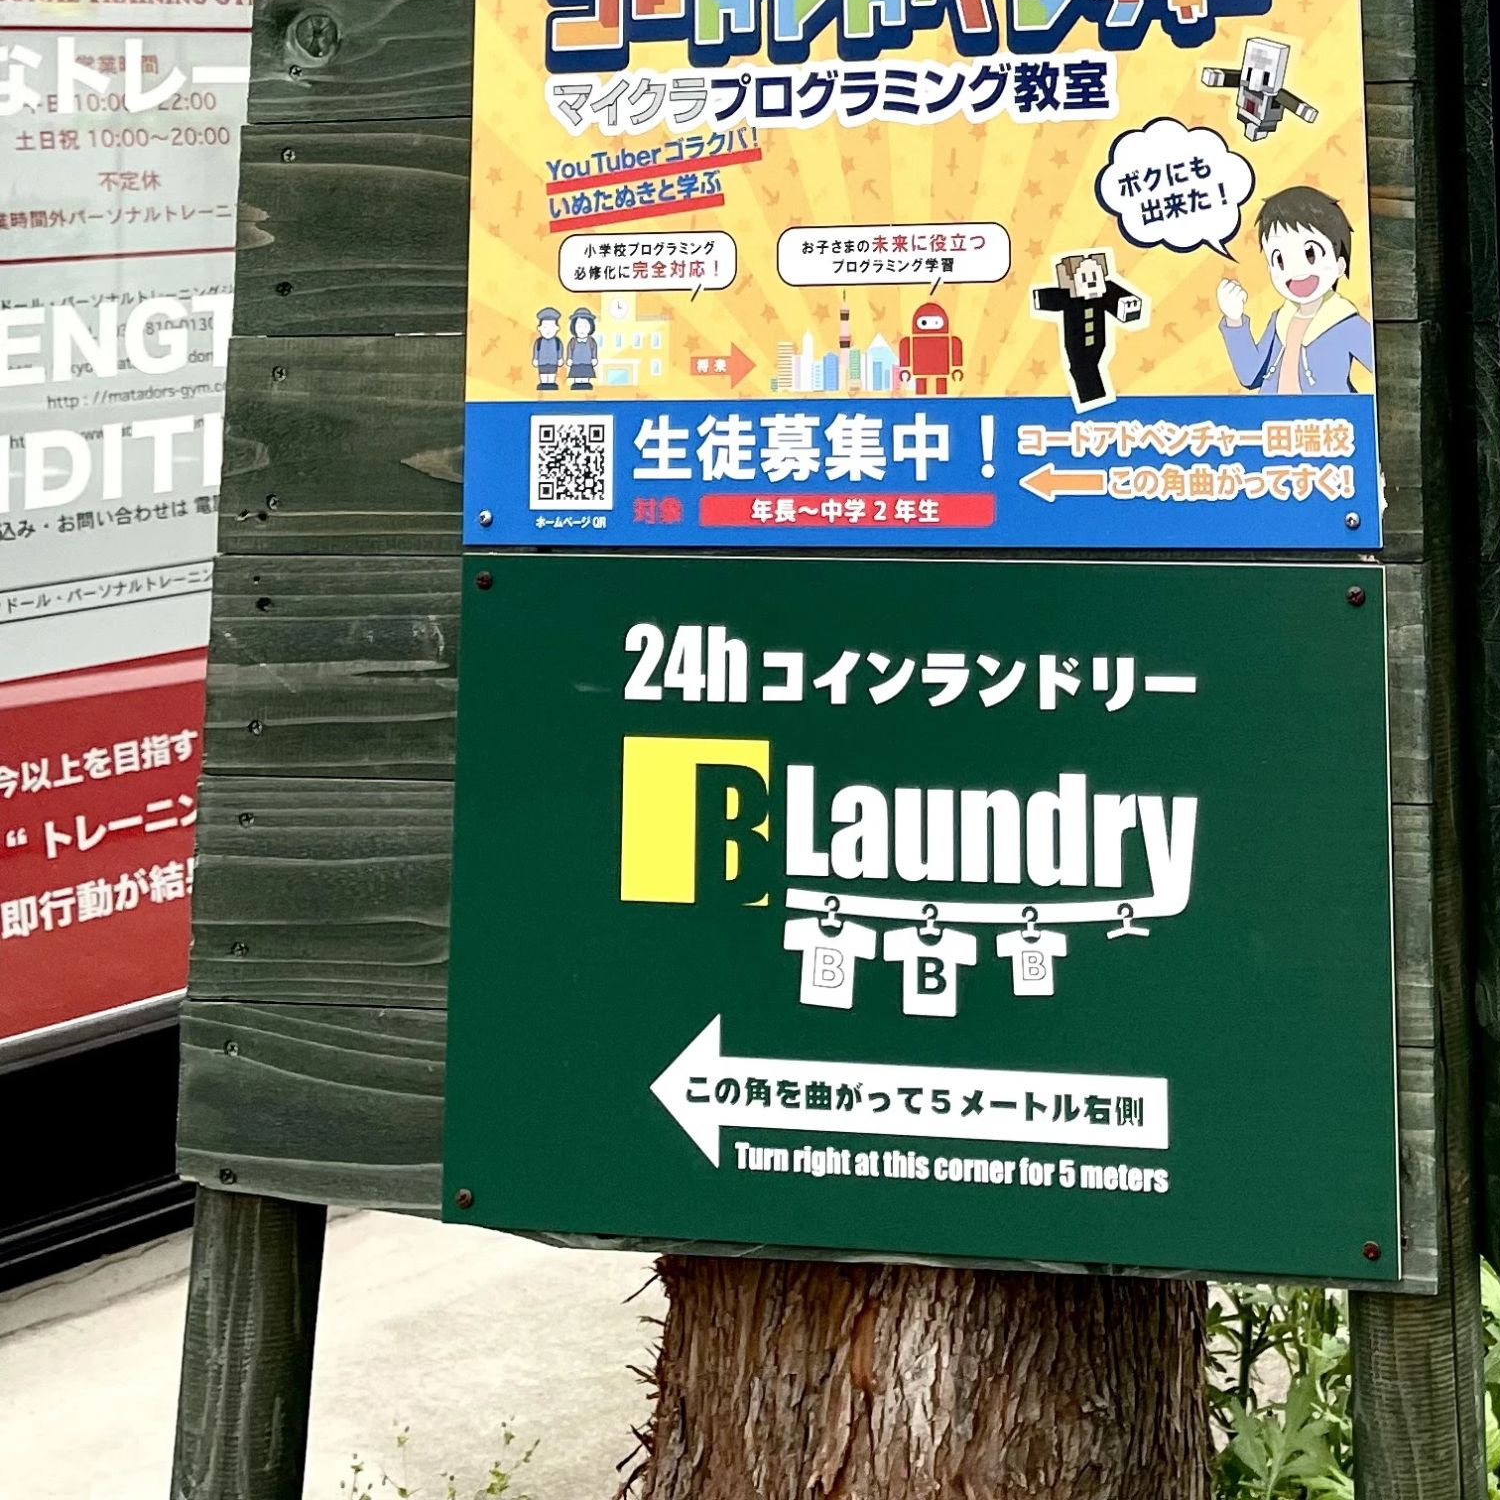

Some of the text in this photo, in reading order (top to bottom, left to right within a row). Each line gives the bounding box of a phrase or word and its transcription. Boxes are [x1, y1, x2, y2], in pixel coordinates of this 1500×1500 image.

[552, 59, 1111, 128] マイクラプログラミング教室
[16, 129, 79, 151] 土日祝
[99, 171, 162, 192] 不定休
[549, 169, 722, 219] いぬたぬきと学ぶ
[1118, 156, 1213, 198] ボクにも
[1140, 182, 1228, 226] 出来た！
[583, 240, 716, 259] 小学校プログラミング
[801, 233, 987, 255] お子さまの未来に役立つ
[832, 256, 955, 274] プログラミング学習
[632, 411, 995, 483] 生徒募集中！
[1019, 420, 1355, 457] コードアドベンチャー田端校
[0, 411, 222, 515] DITI
[1107, 465, 1354, 499] この角曲がってすぐ!
[786, 765, 1198, 922] Laundry
[915, 957, 947, 995] B
[685, 1077, 1145, 1128] この角を曲がって5メートル右側
[734, 1141, 1169, 1194] Turn right at this corner for 5 meters
